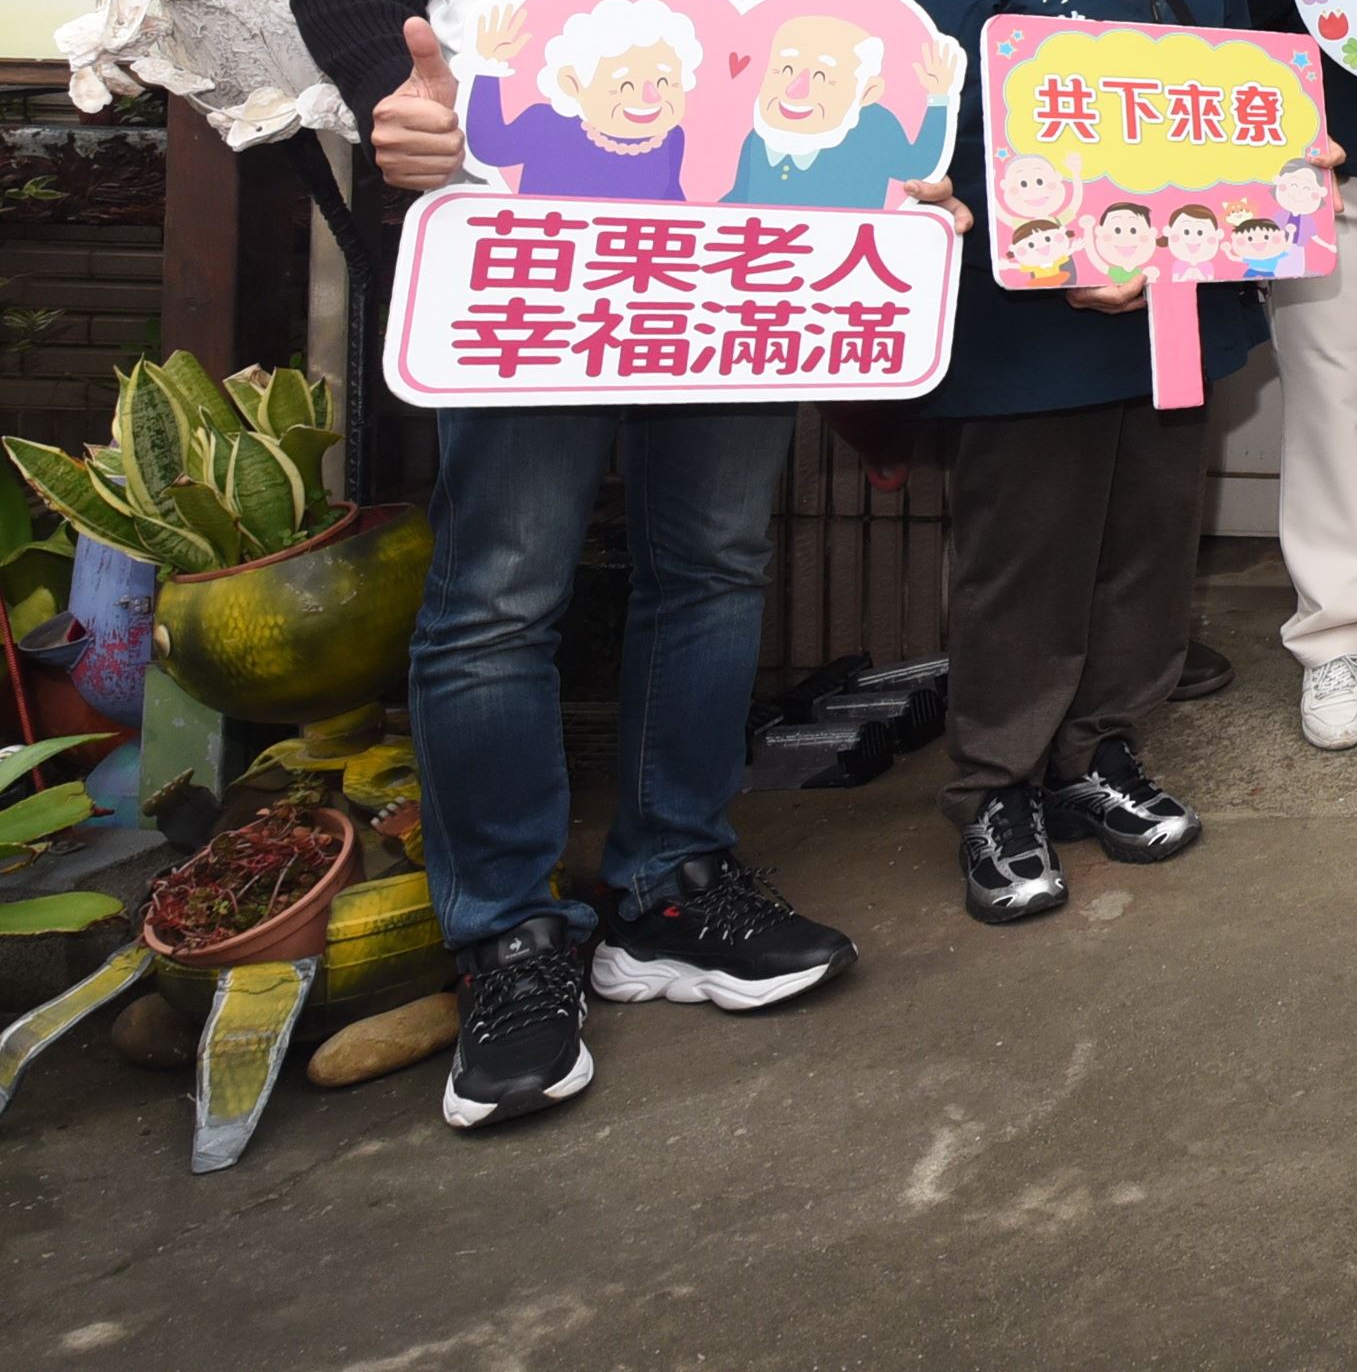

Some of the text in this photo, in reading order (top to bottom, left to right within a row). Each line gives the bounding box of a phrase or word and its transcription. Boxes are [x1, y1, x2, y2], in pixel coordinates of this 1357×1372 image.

[465, 208, 914, 294] 苗栗老人
[450, 296, 911, 379] 幸福滿滿
